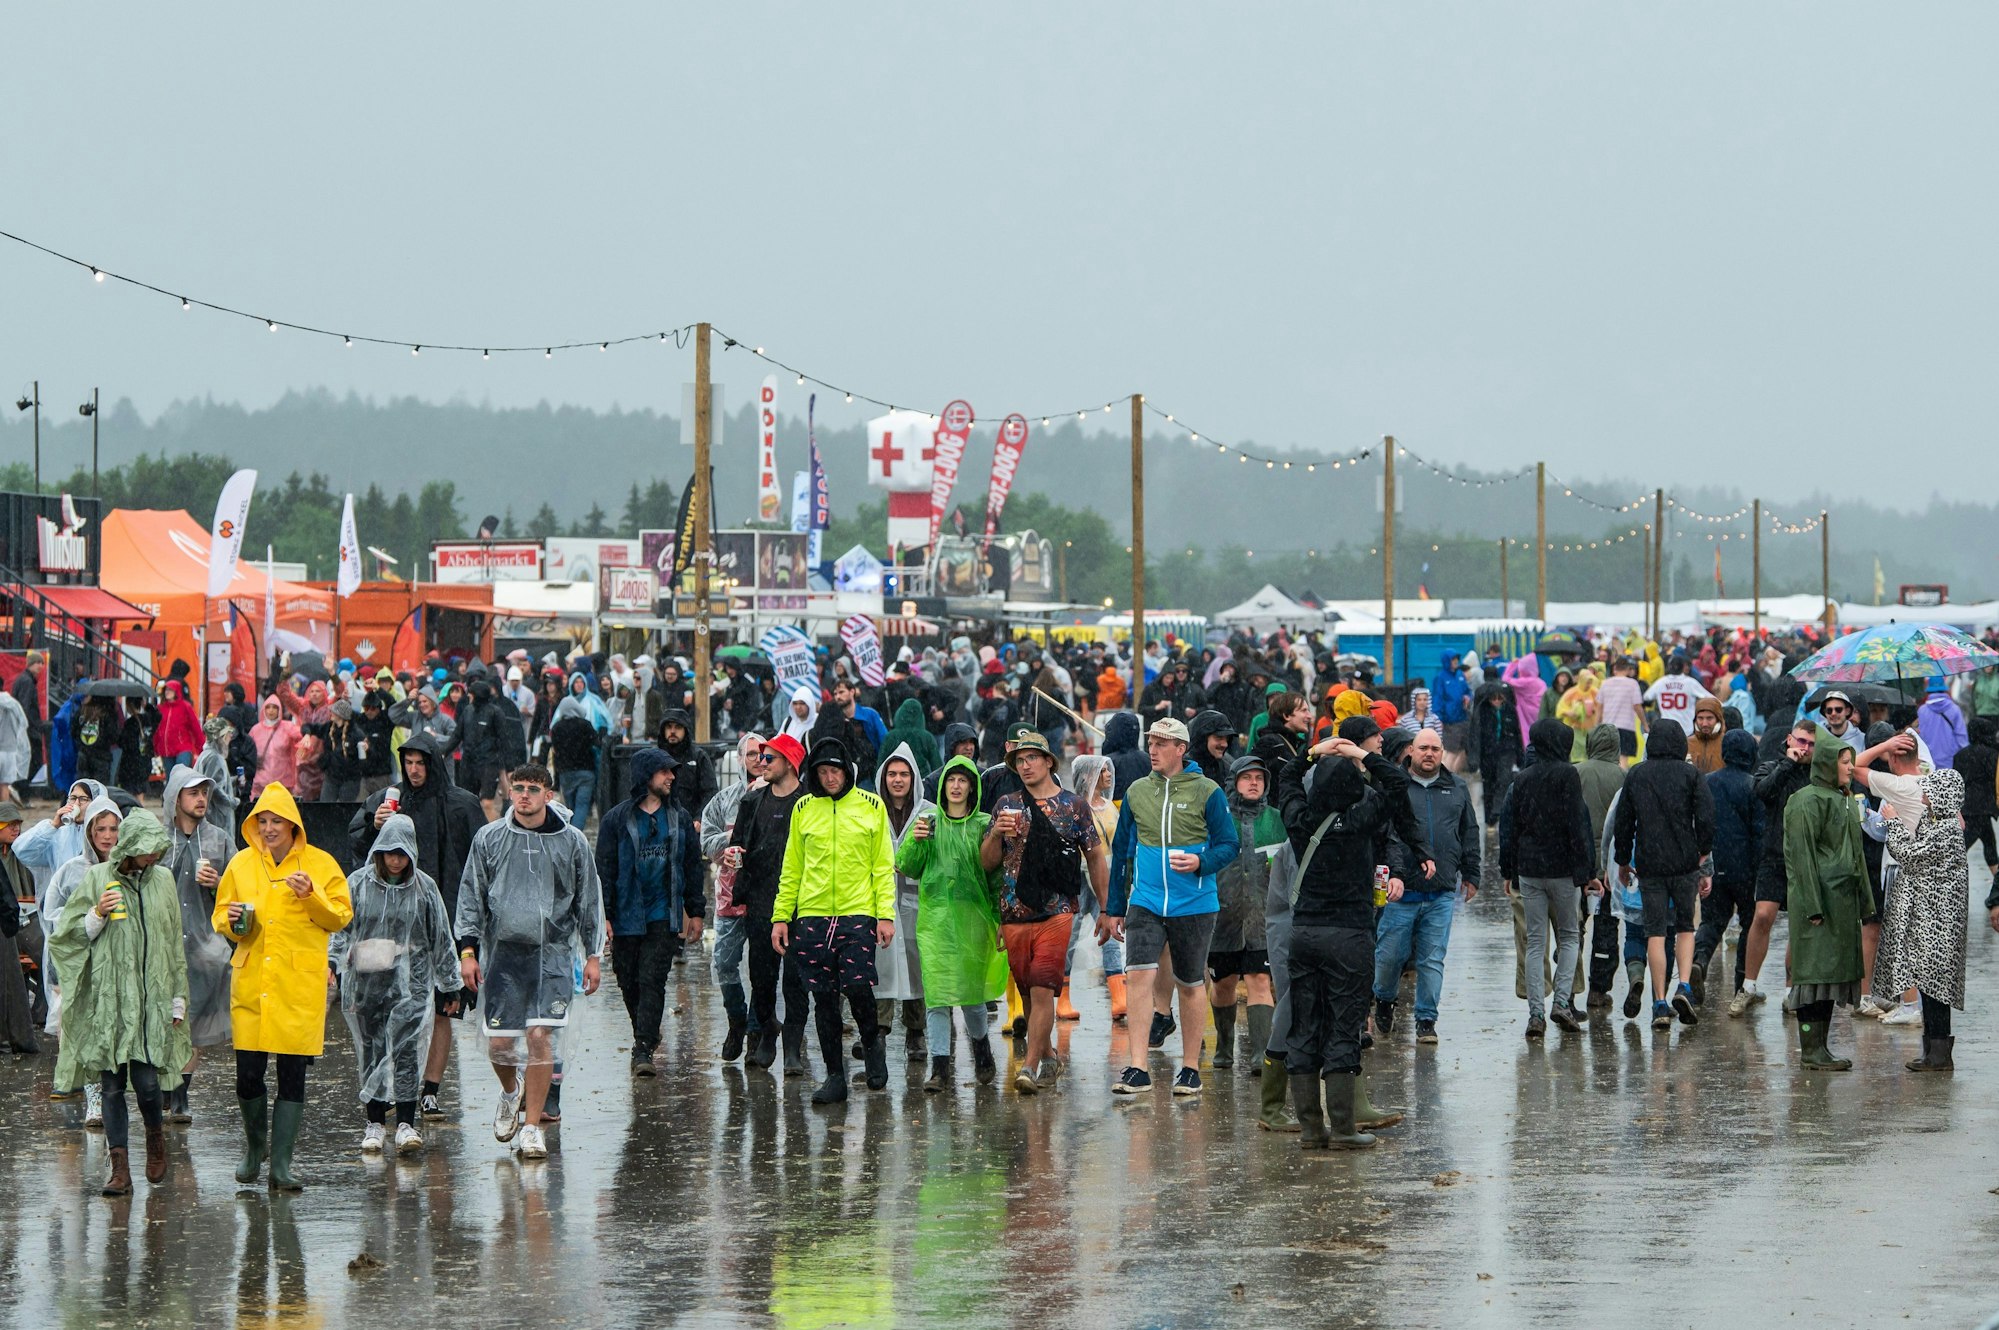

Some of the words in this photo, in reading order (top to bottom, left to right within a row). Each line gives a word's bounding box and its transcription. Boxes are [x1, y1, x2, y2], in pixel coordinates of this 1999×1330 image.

[930, 432, 965, 510] HOT-DOG
[37, 515, 87, 572] Winston
[446, 552, 529, 567] Abholmarkt
[615, 577, 648, 606] Langos
[1661, 692, 1687, 710] 50
